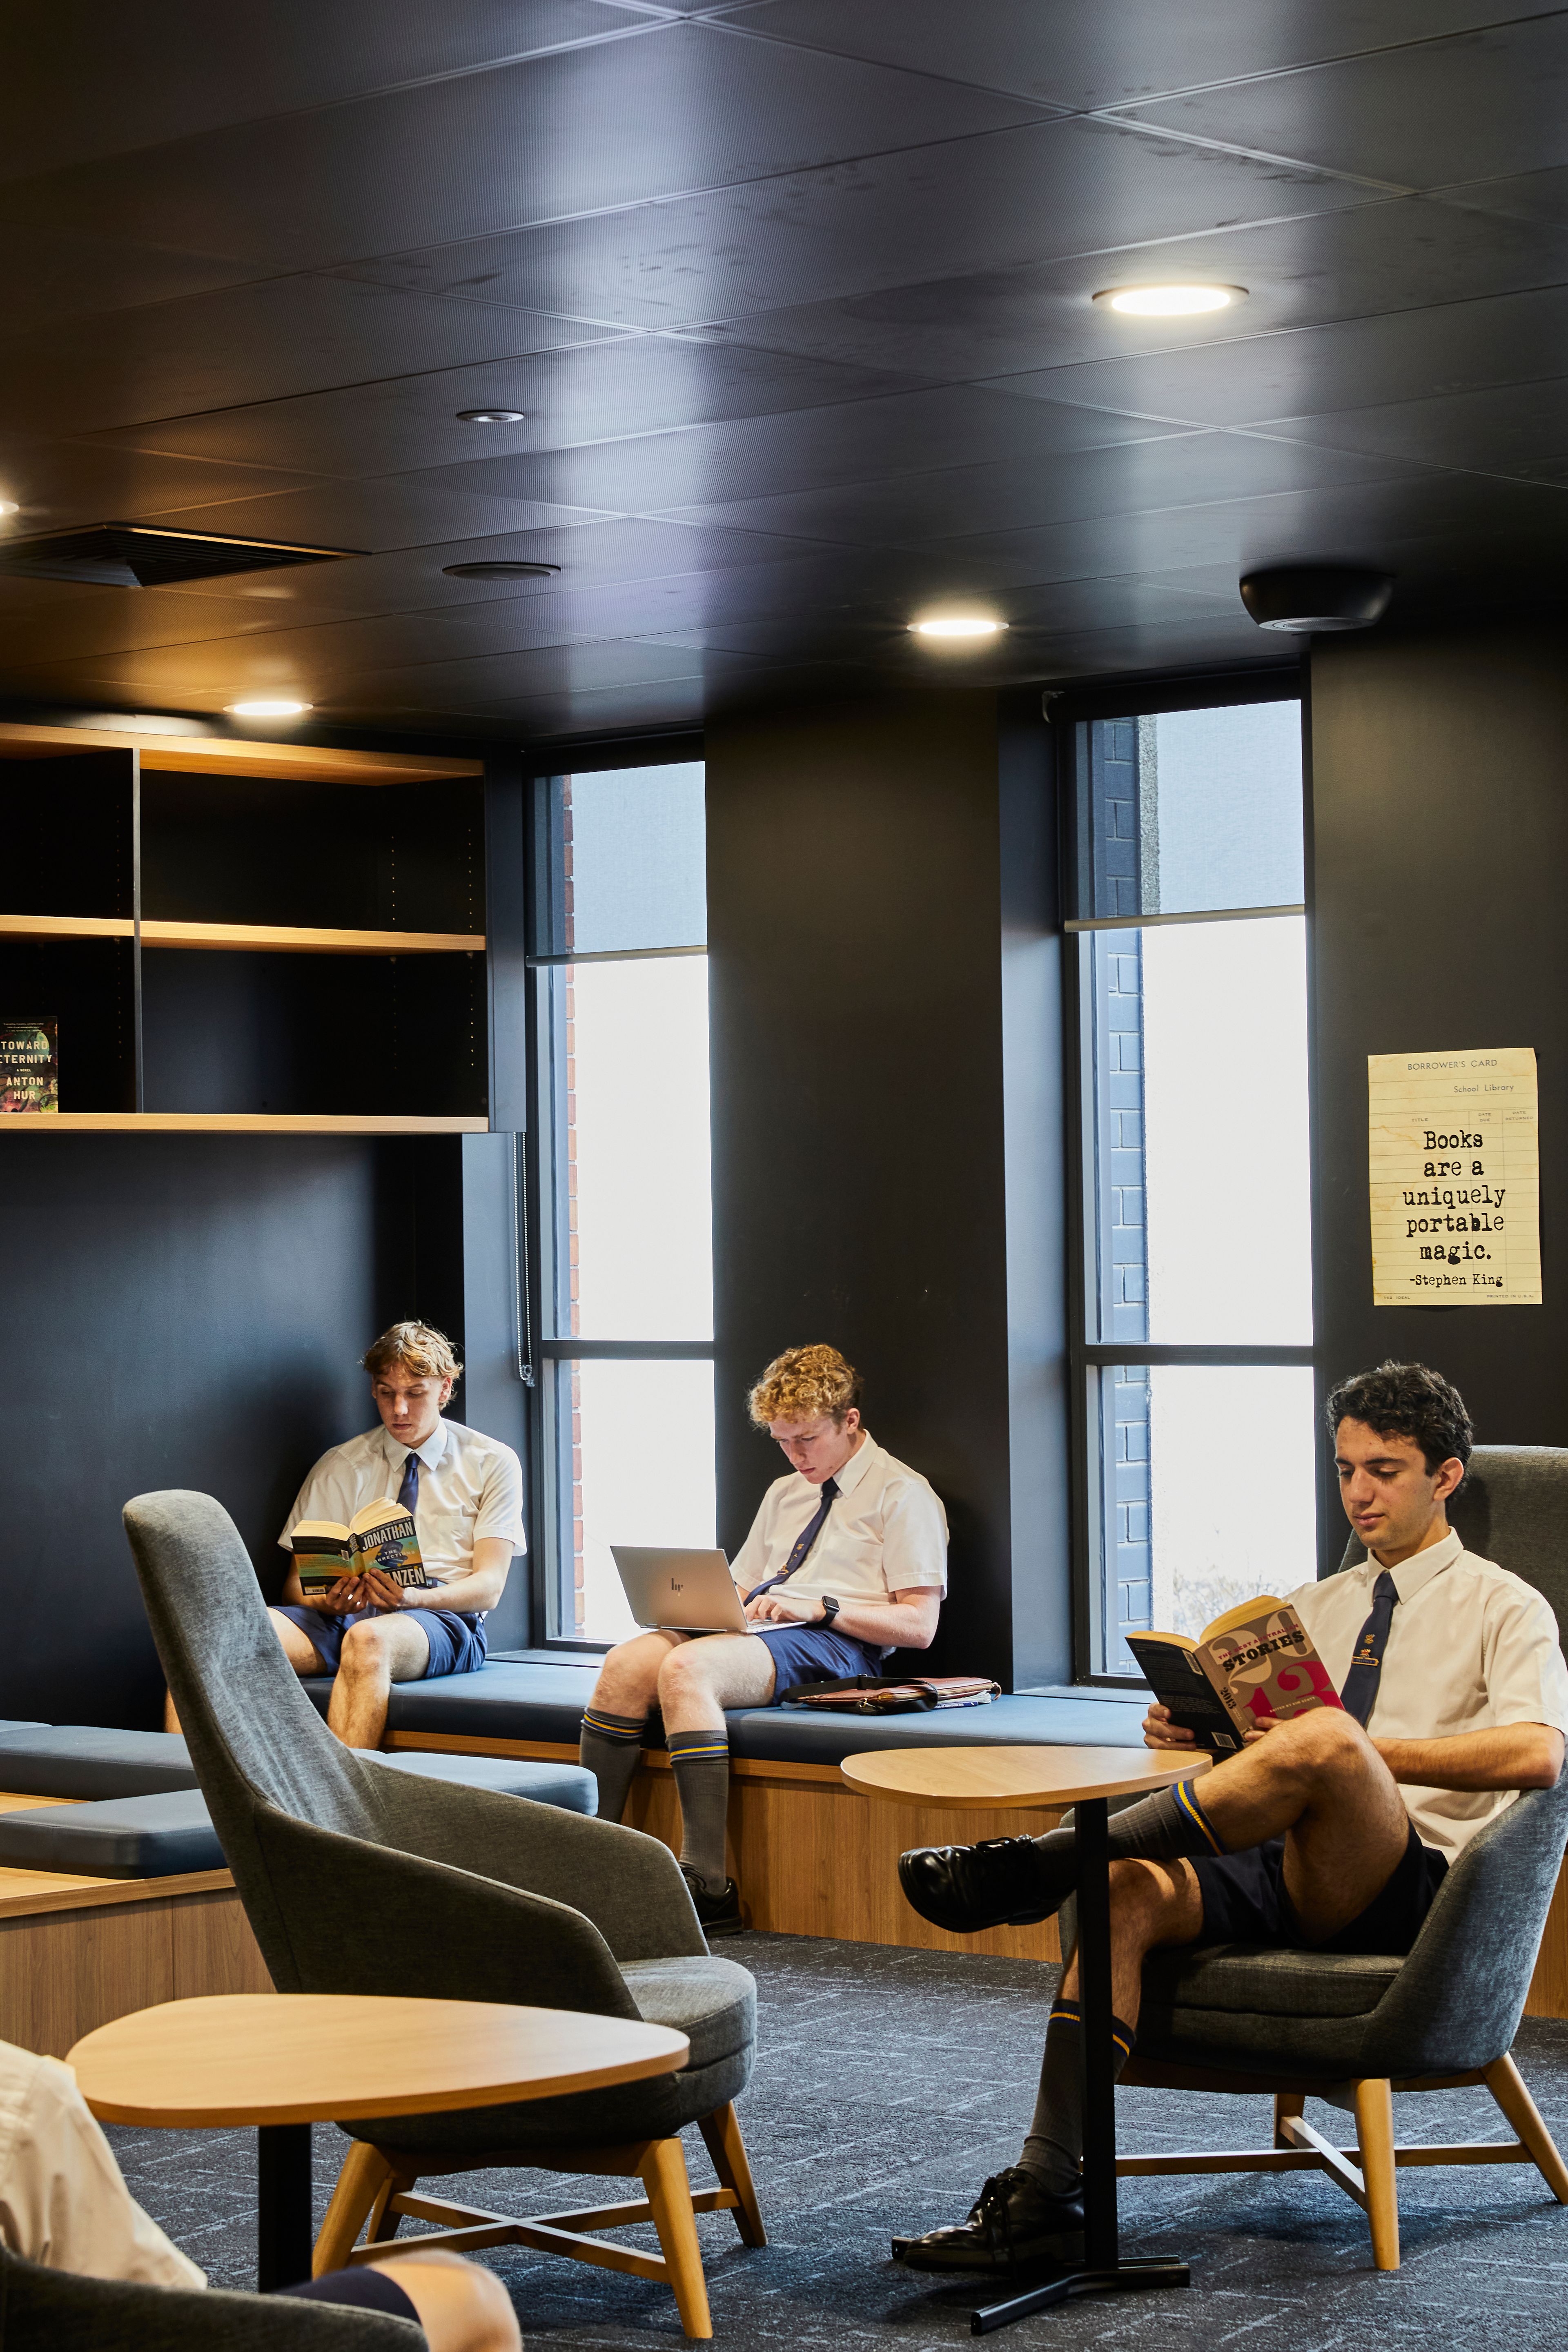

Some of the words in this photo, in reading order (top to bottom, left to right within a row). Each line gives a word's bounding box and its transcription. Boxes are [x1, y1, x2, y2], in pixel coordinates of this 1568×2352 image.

[0, 1041, 48, 1050] TOWARD
[1408, 1060, 1466, 1070] BORROWER'S
[6, 1077, 43, 1086] ANTON
[1454, 1085, 1479, 1093] School
[1484, 1084, 1515, 1092] Library
[13, 1090, 36, 1100] HUR
[1423, 1129, 1483, 1150] Books
[1423, 1161, 1461, 1177] are
[1472, 1160, 1484, 1176] a
[1403, 1185, 1506, 1209] uniquely
[1406, 1213, 1504, 1237] portable
[1419, 1241, 1491, 1265] magic.
[1410, 1274, 1467, 1288] -Stephen
[1473, 1274, 1503, 1287] King
[362, 1521, 414, 1551] JONATHAN
[369, 1550, 415, 1565] CORRECTIONS
[1218, 1650, 1233, 1660] THE
[1234, 1641, 1252, 1652] BEST
[1254, 1623, 1299, 1644] AUSTRALIAN
[1223, 1630, 1305, 1672] STORIES
[1220, 1687, 1236, 1709] 2013
